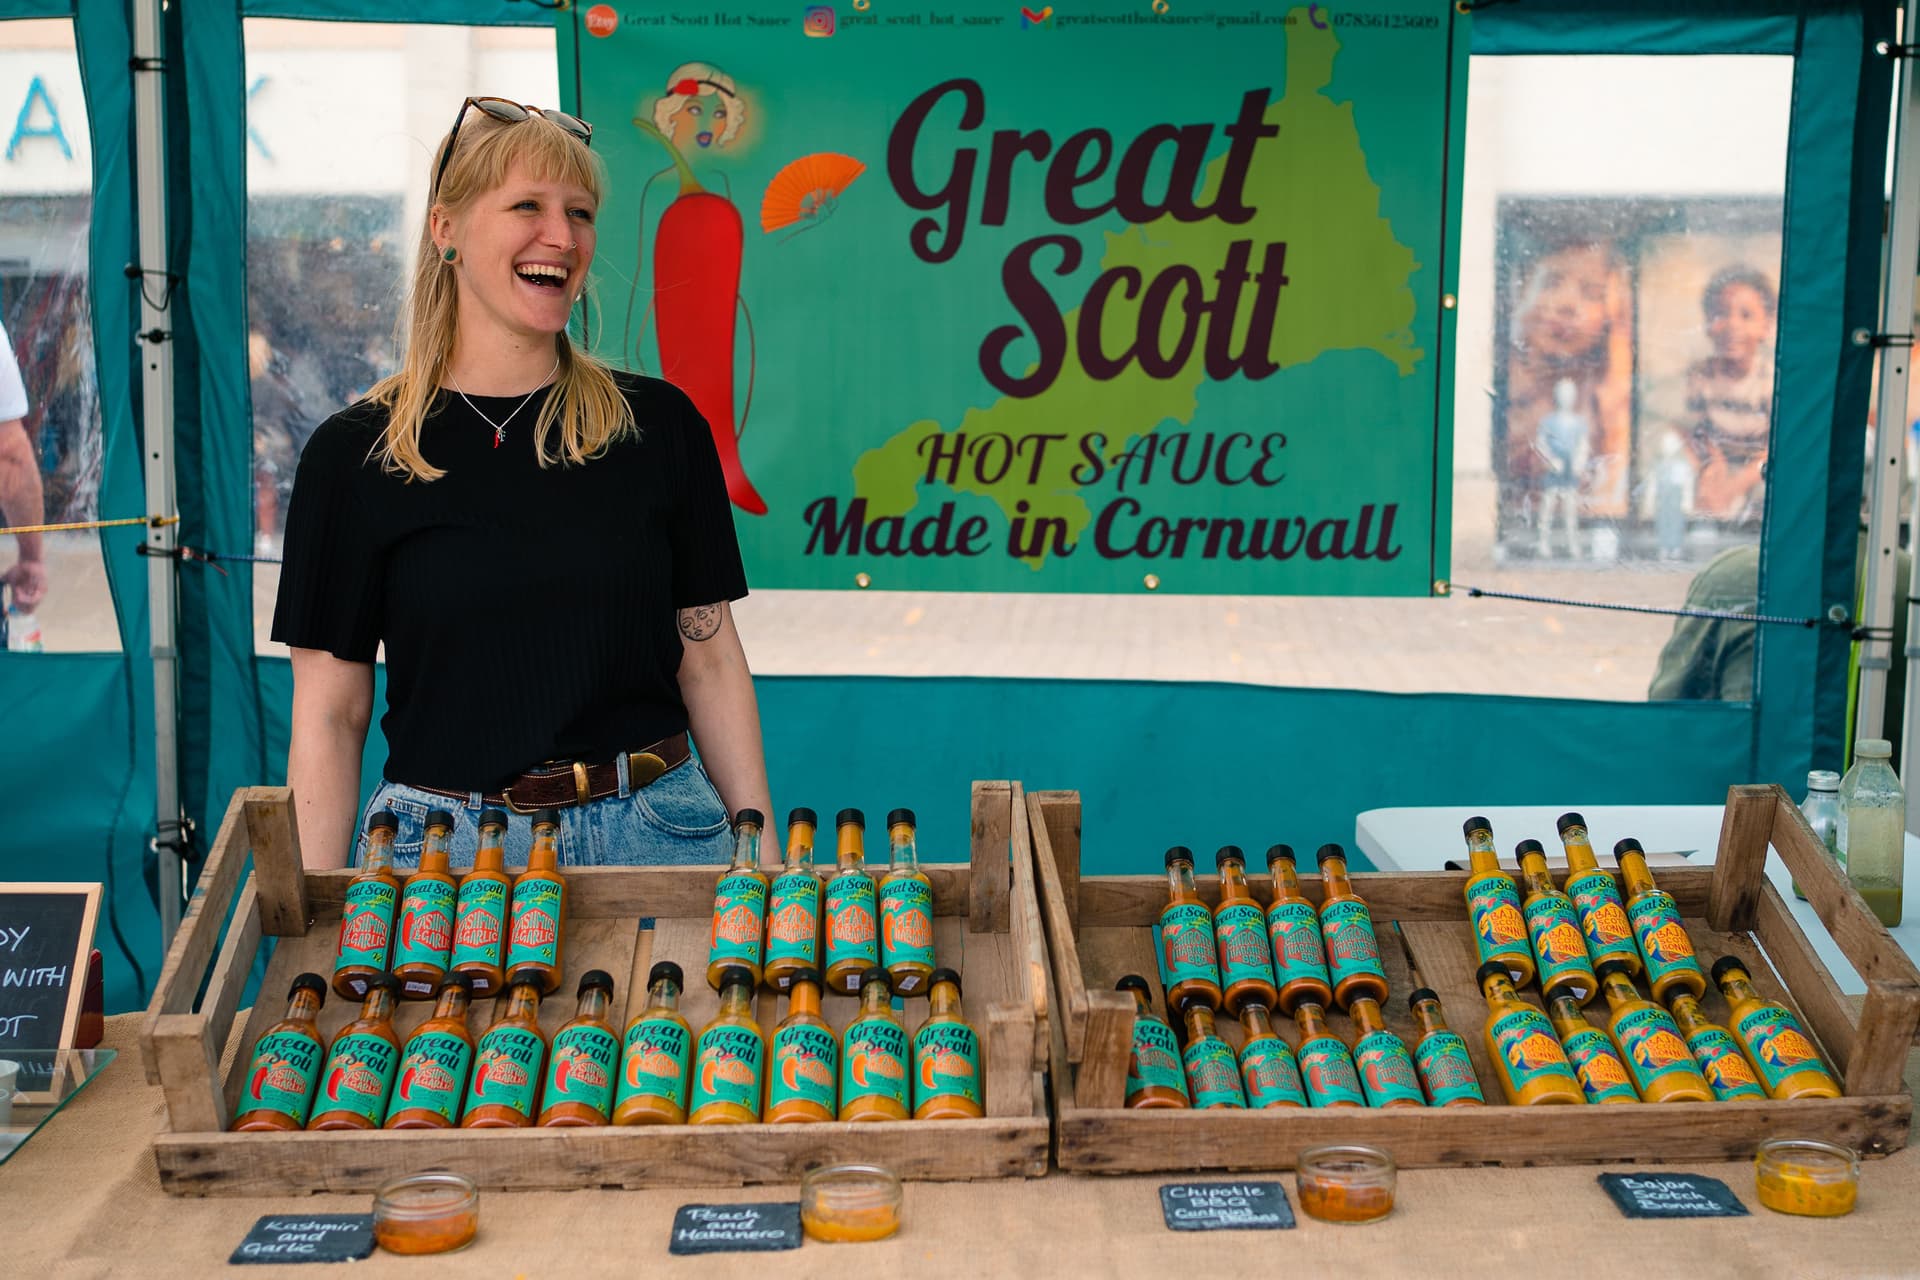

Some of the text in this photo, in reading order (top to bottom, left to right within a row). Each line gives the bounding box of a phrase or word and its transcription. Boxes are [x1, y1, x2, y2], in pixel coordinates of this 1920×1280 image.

[714, 12, 741, 26] Hot
[887, 77, 1281, 263] Great
[978, 233, 1289, 399] Scott
[917, 432, 1288, 493] HOT SAUCE
[803, 496, 1403, 560] Made in Cornwall
[3, 965, 66, 987] WITH
[482, 1031, 538, 1050] Great
[558, 1029, 614, 1050] Great
[629, 1024, 685, 1044] Great
[703, 1028, 758, 1050] Great
[781, 1027, 834, 1048] Great
[850, 1023, 904, 1044] Great
[918, 1027, 972, 1048] Great
[259, 1035, 318, 1057] Great
[335, 1036, 393, 1059] Great
[408, 1036, 464, 1058] Great
[490, 1045, 534, 1065] Scott
[571, 1042, 611, 1066] Scott
[640, 1037, 682, 1056] Scott
[716, 1043, 756, 1065] Scott
[796, 1041, 833, 1066] Scott
[865, 1037, 904, 1058] Scott
[932, 1039, 972, 1057] Scott
[269, 1049, 313, 1072] Scott
[346, 1050, 388, 1075] Scott
[417, 1049, 460, 1071] Scott
[1169, 1186, 1265, 1199] Chipotle
[1620, 1177, 1695, 1193] Bajan
[1632, 1189, 1707, 1200] Scotch
[1190, 1196, 1249, 1208] BBQ
[1637, 1199, 1722, 1211] Bonnet
[686, 1207, 761, 1221] Peach
[706, 1218, 756, 1230] and
[263, 1220, 364, 1232] Kashmiri
[277, 1230, 327, 1243] and
[678, 1228, 786, 1241] Habanero
[243, 1242, 317, 1256] Garlic
